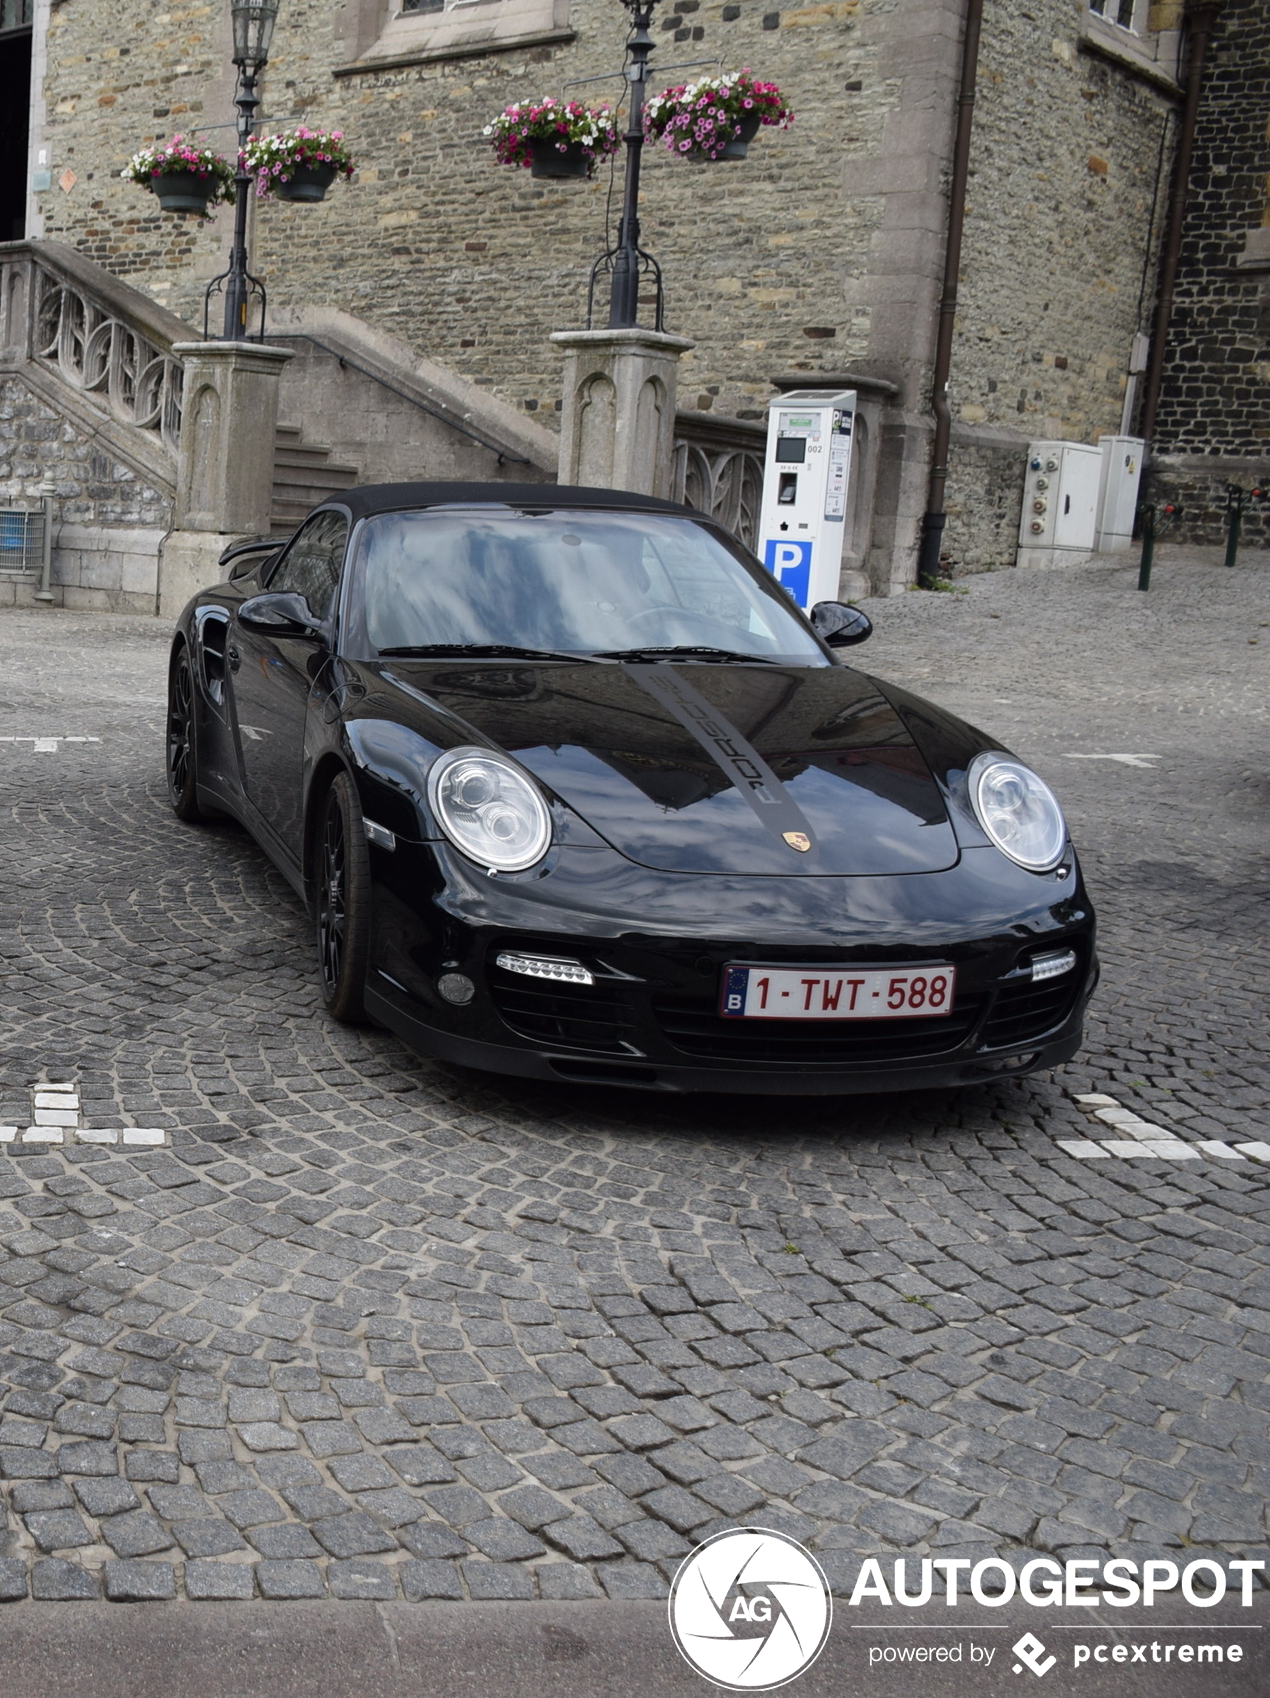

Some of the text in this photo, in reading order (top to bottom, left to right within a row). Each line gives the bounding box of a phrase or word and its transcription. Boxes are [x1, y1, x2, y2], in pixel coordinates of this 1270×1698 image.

[807, 445, 823, 453] 002
[773, 543, 803, 582] P
[648, 675, 783, 805] PORSCHE
[728, 994, 742, 1010] B
